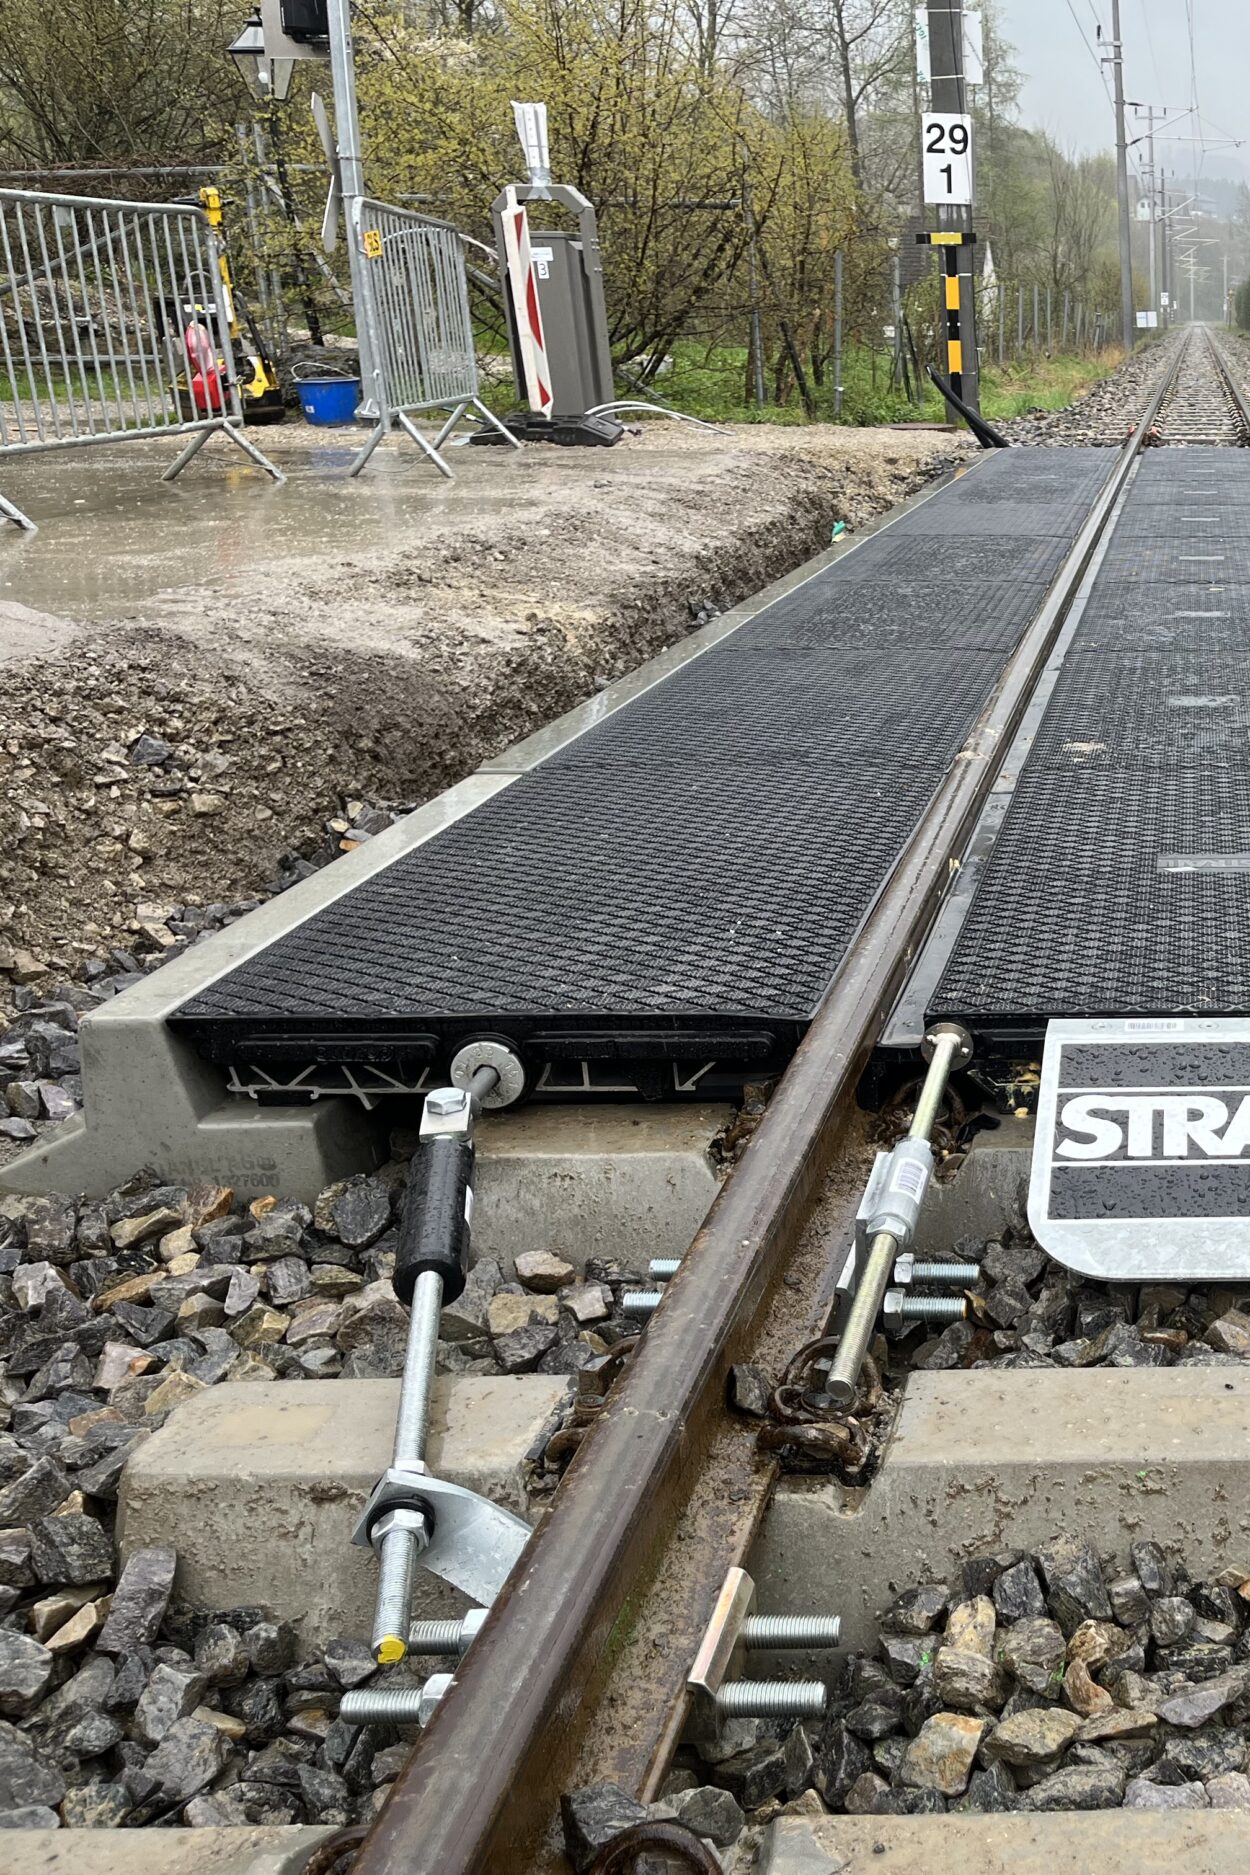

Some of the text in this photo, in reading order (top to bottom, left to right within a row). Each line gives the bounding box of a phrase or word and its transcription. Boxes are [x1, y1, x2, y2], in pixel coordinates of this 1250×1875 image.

[926, 123, 969, 155] 29
[939, 163, 952, 194] 1
[539, 263, 547, 276] 3
